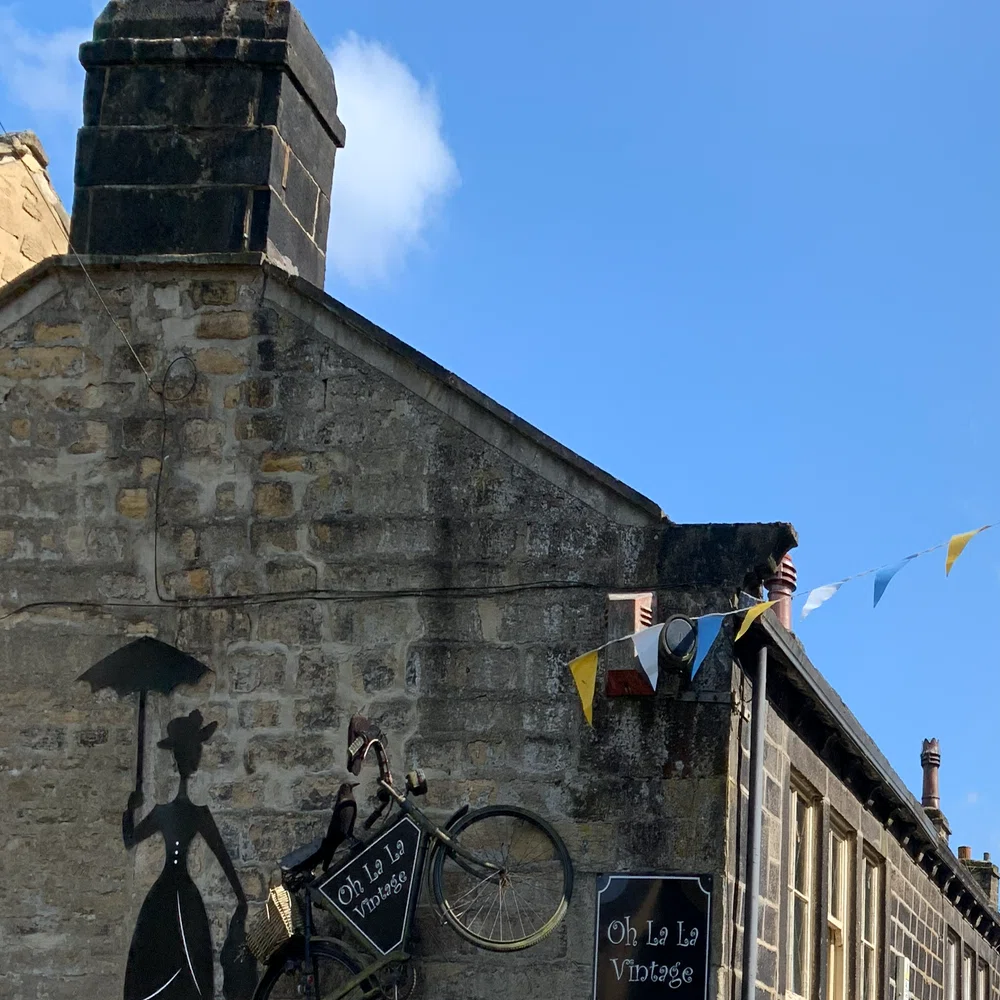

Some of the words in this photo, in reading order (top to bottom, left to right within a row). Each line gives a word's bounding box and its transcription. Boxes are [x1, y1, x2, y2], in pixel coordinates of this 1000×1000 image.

[338, 875, 364, 905] Oh
[362, 859, 384, 884] La
[384, 839, 405, 864] La
[352, 870, 407, 918] Vintage
[607, 916, 637, 947] Oh
[646, 920, 668, 946] La
[677, 921, 699, 947] La
[610, 958, 693, 989] Vintage
